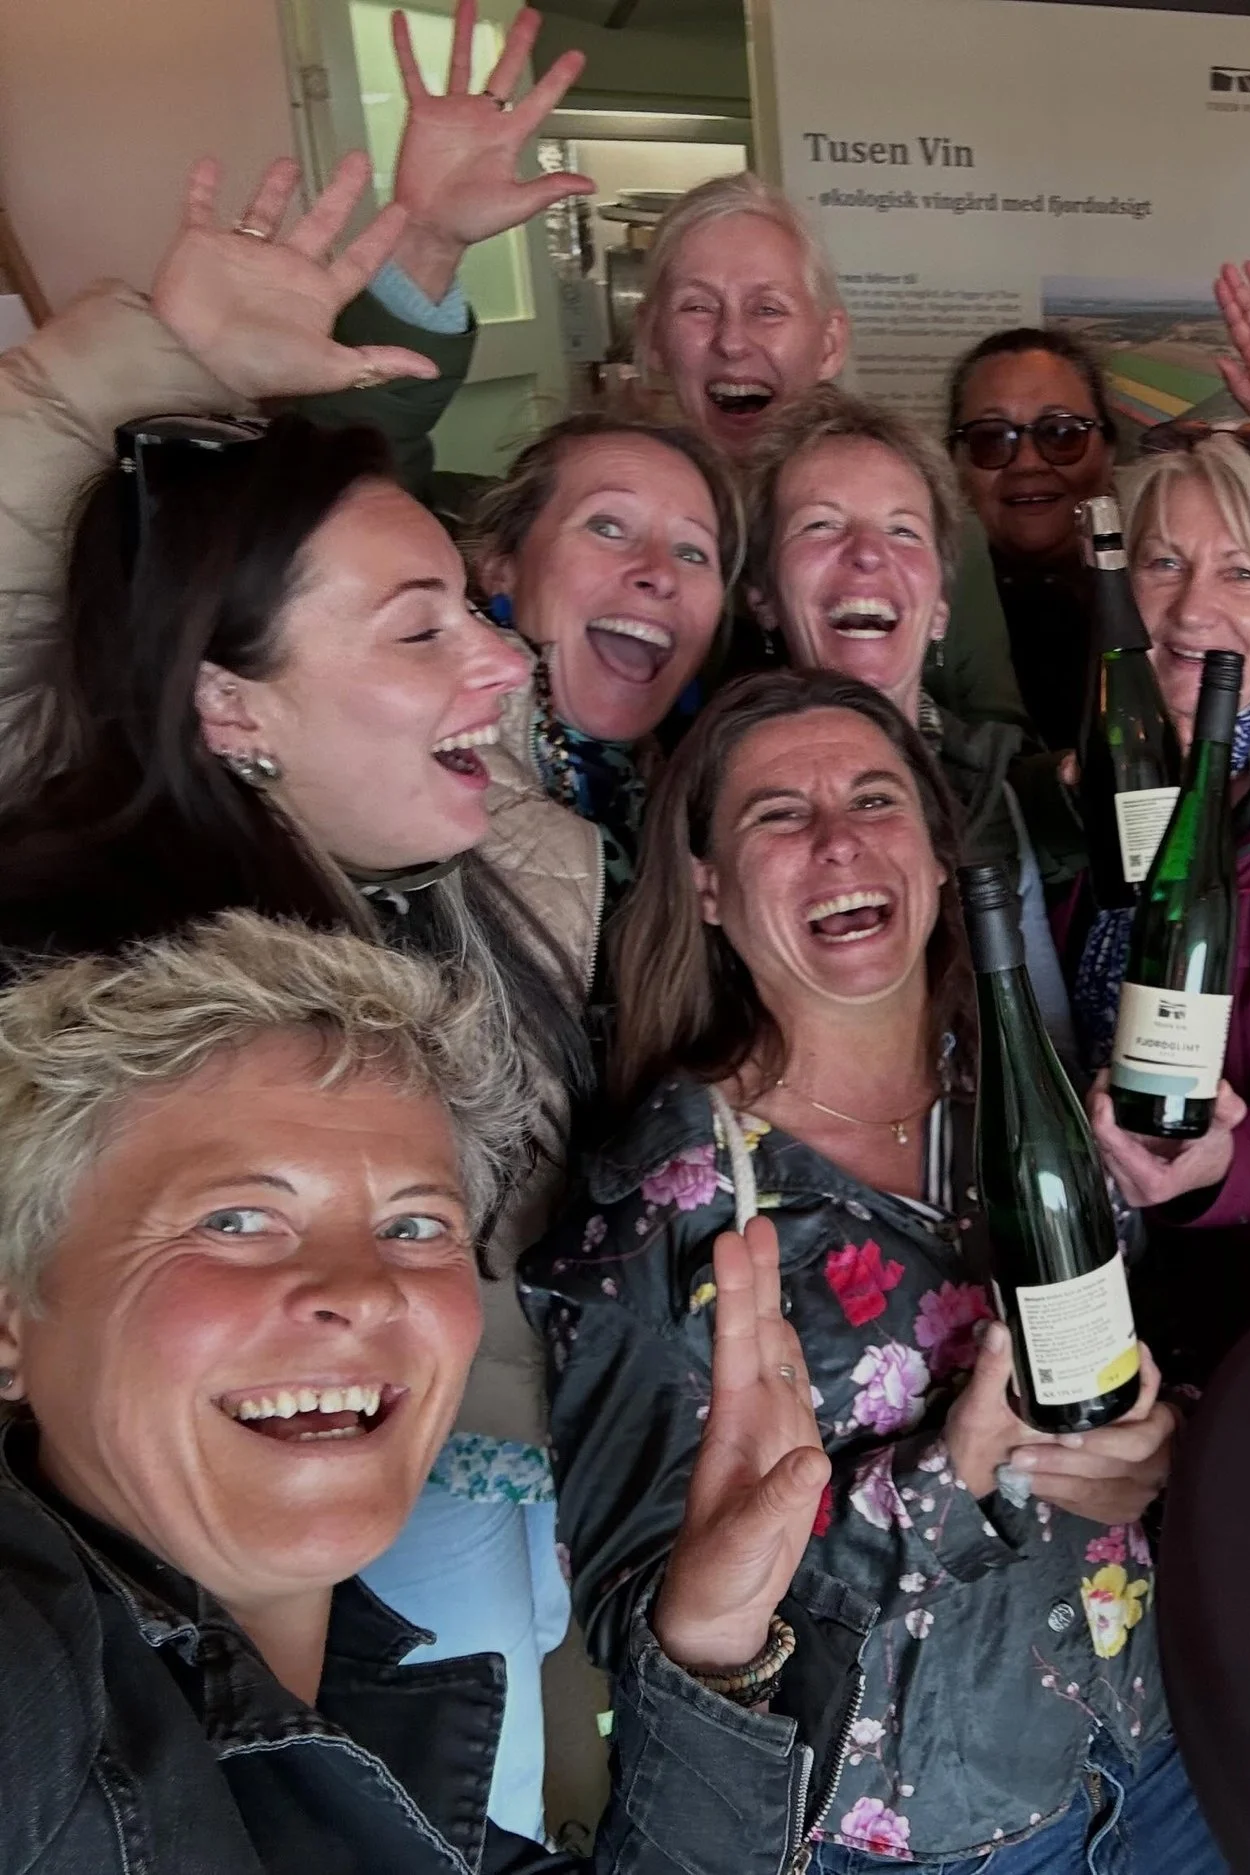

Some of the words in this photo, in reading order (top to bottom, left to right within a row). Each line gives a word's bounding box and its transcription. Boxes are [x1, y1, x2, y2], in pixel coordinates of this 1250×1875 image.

[803, 132, 911, 165] Tusen
[917, 136, 975, 168] Vin
[819, 188, 919, 212] økologisk
[1001, 194, 1045, 212] med
